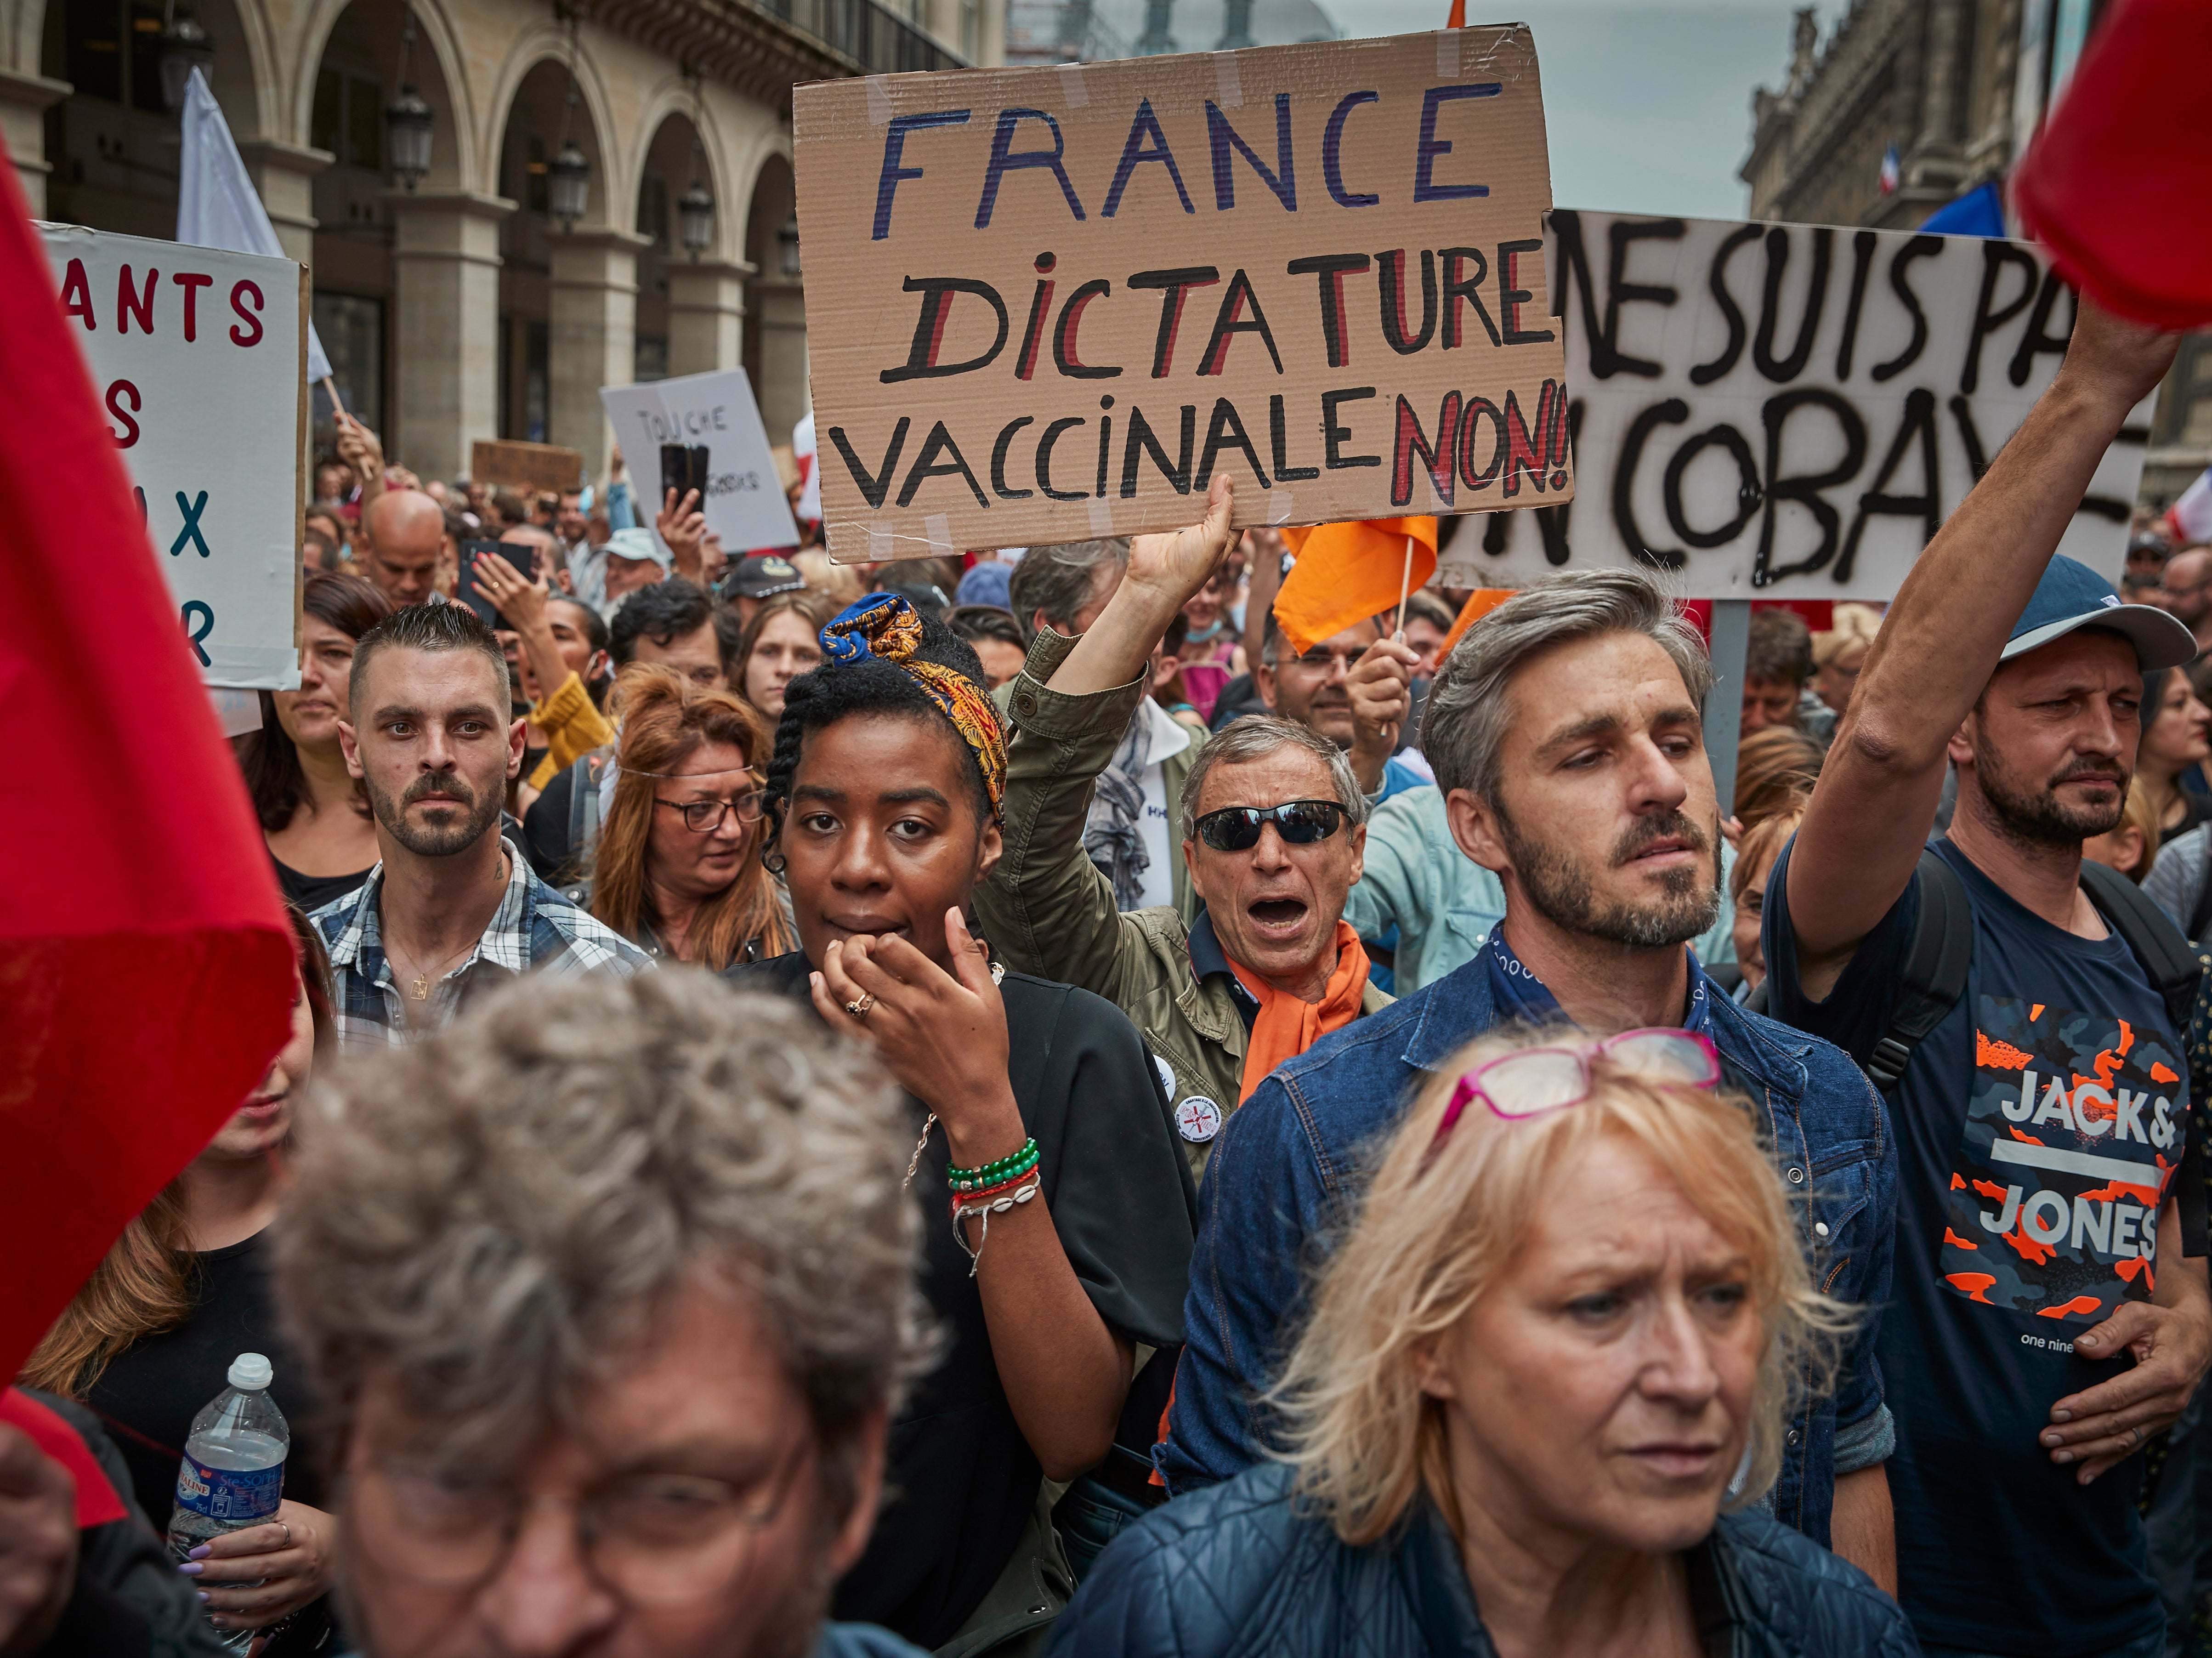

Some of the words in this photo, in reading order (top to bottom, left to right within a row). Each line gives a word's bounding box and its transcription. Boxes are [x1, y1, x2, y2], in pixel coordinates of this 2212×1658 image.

[872, 82, 1503, 241] FRANCE
[1548, 210, 1685, 380] NE
[1689, 222, 1945, 385] SUIS
[1390, 378, 1571, 507] NON!
[1613, 387, 2153, 587] COBA
[1180, 1106, 1199, 1120] C'EST
[1197, 1117, 1213, 1130] NON
[1979, 1184, 2157, 1261] JONES
[2021, 1334, 2046, 1348] one
[2048, 1339, 2074, 1353] nine
[196, 1502, 208, 1514] 75cl
